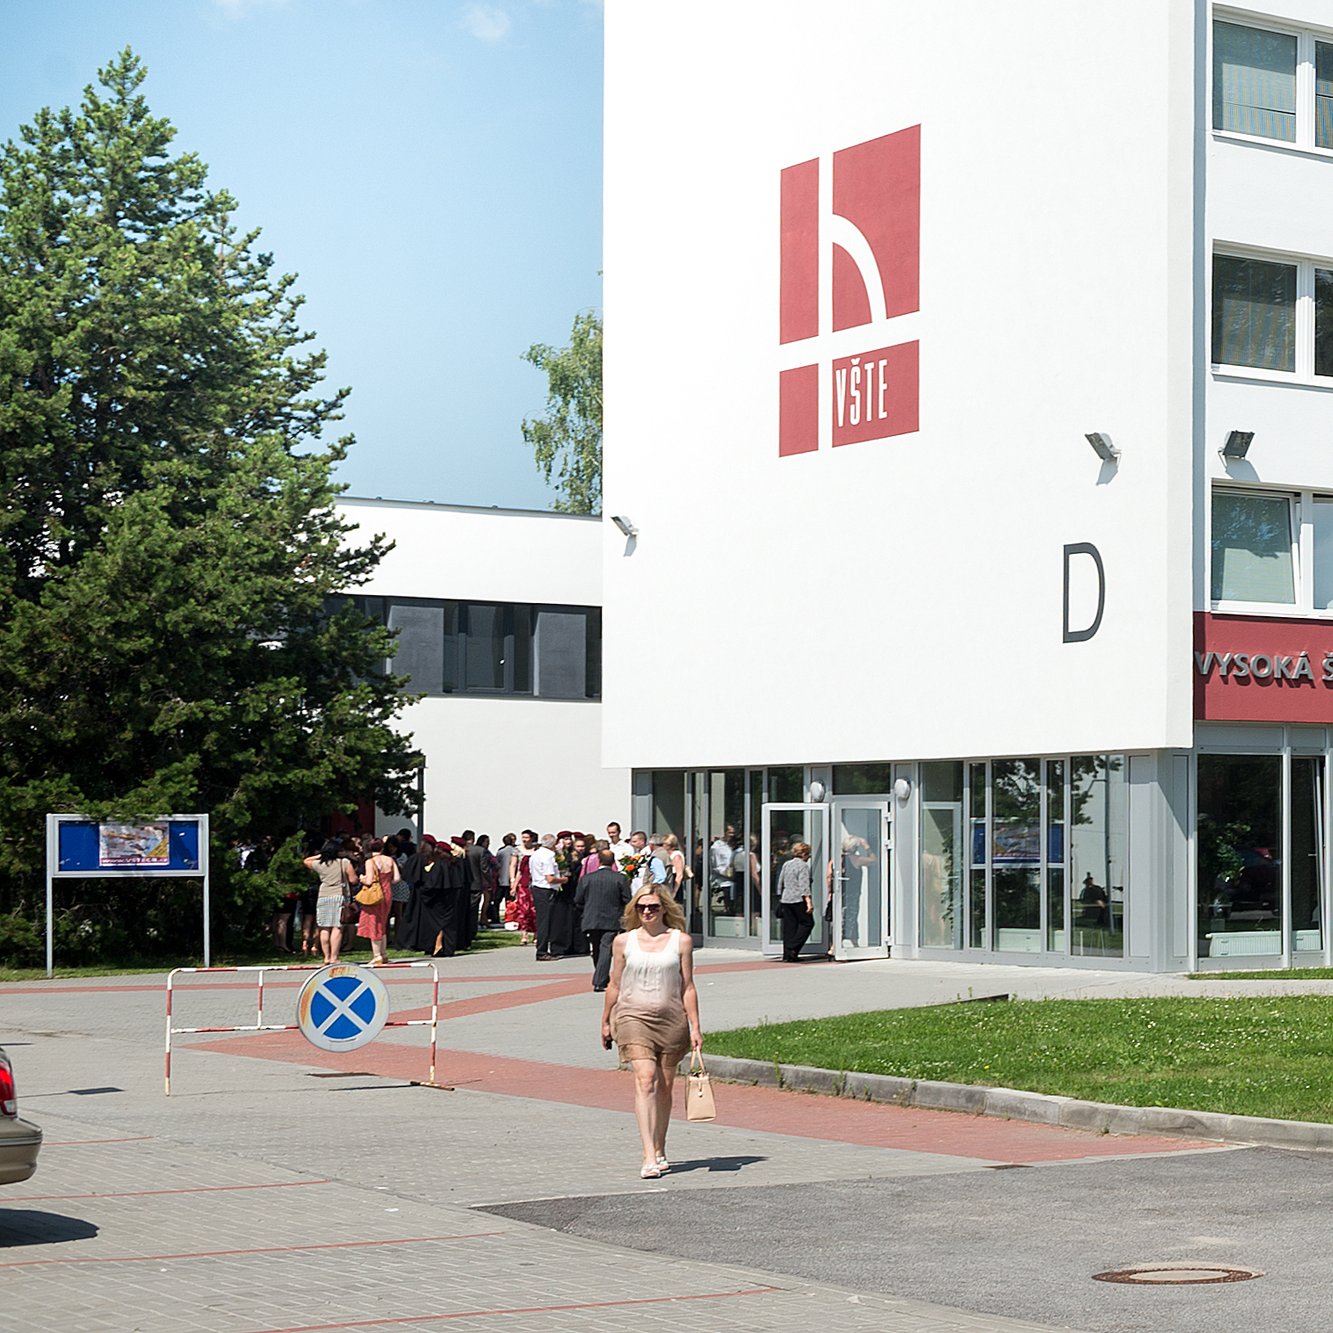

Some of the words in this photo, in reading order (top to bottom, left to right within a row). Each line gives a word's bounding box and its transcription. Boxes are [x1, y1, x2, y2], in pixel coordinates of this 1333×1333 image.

[835, 357, 888, 428] VŠTE
[1062, 541, 1106, 644] D
[1194, 650, 1314, 681] VYSOKÁ
